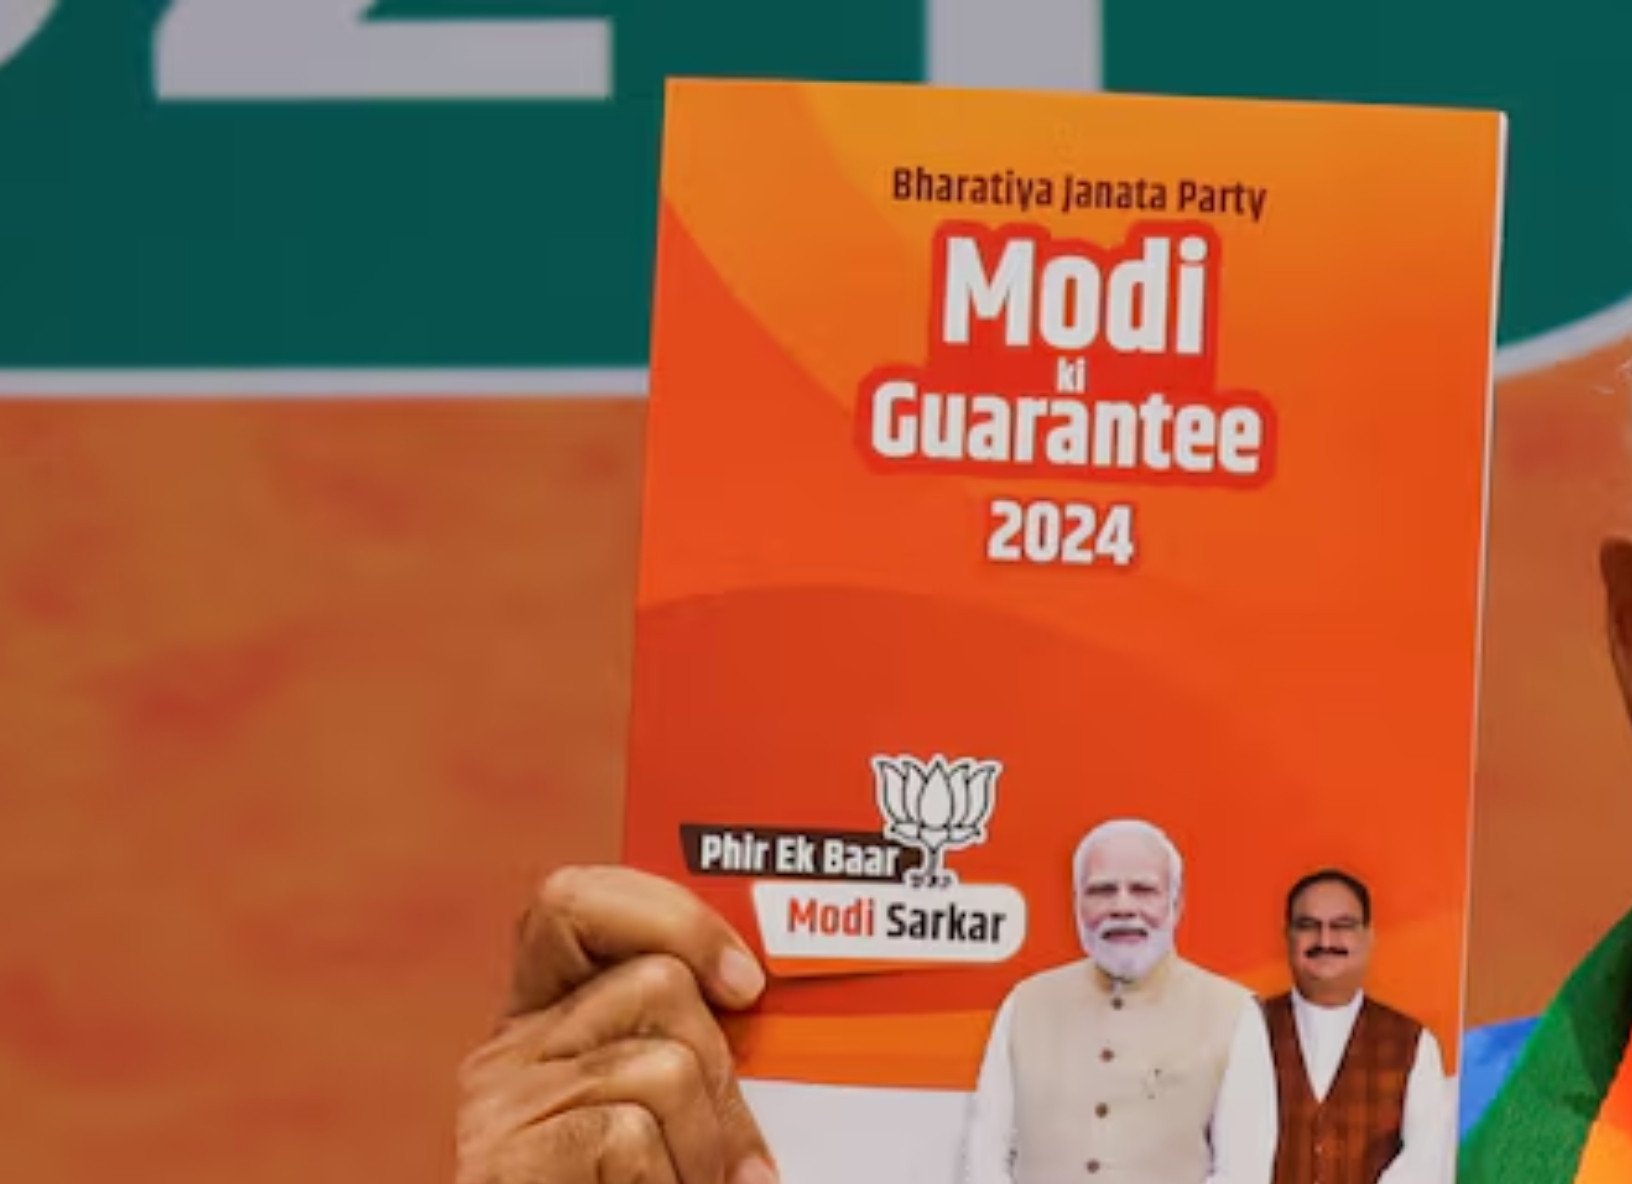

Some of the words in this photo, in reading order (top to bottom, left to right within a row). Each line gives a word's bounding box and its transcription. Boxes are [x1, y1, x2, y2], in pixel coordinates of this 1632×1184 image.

[892, 166, 1053, 212] Bharatiya
[1062, 176, 1167, 212] Janata
[1177, 179, 1267, 221] Party
[942, 236, 1208, 354] Modi
[1057, 358, 1086, 393] ki
[871, 381, 1263, 473] Guarantee
[987, 501, 1134, 565] 2024
[699, 833, 769, 872] Phir
[774, 838, 816, 874] Ek
[822, 841, 901, 877] Baar
[786, 898, 875, 936] Modi
[885, 902, 1006, 943] Sarkar
